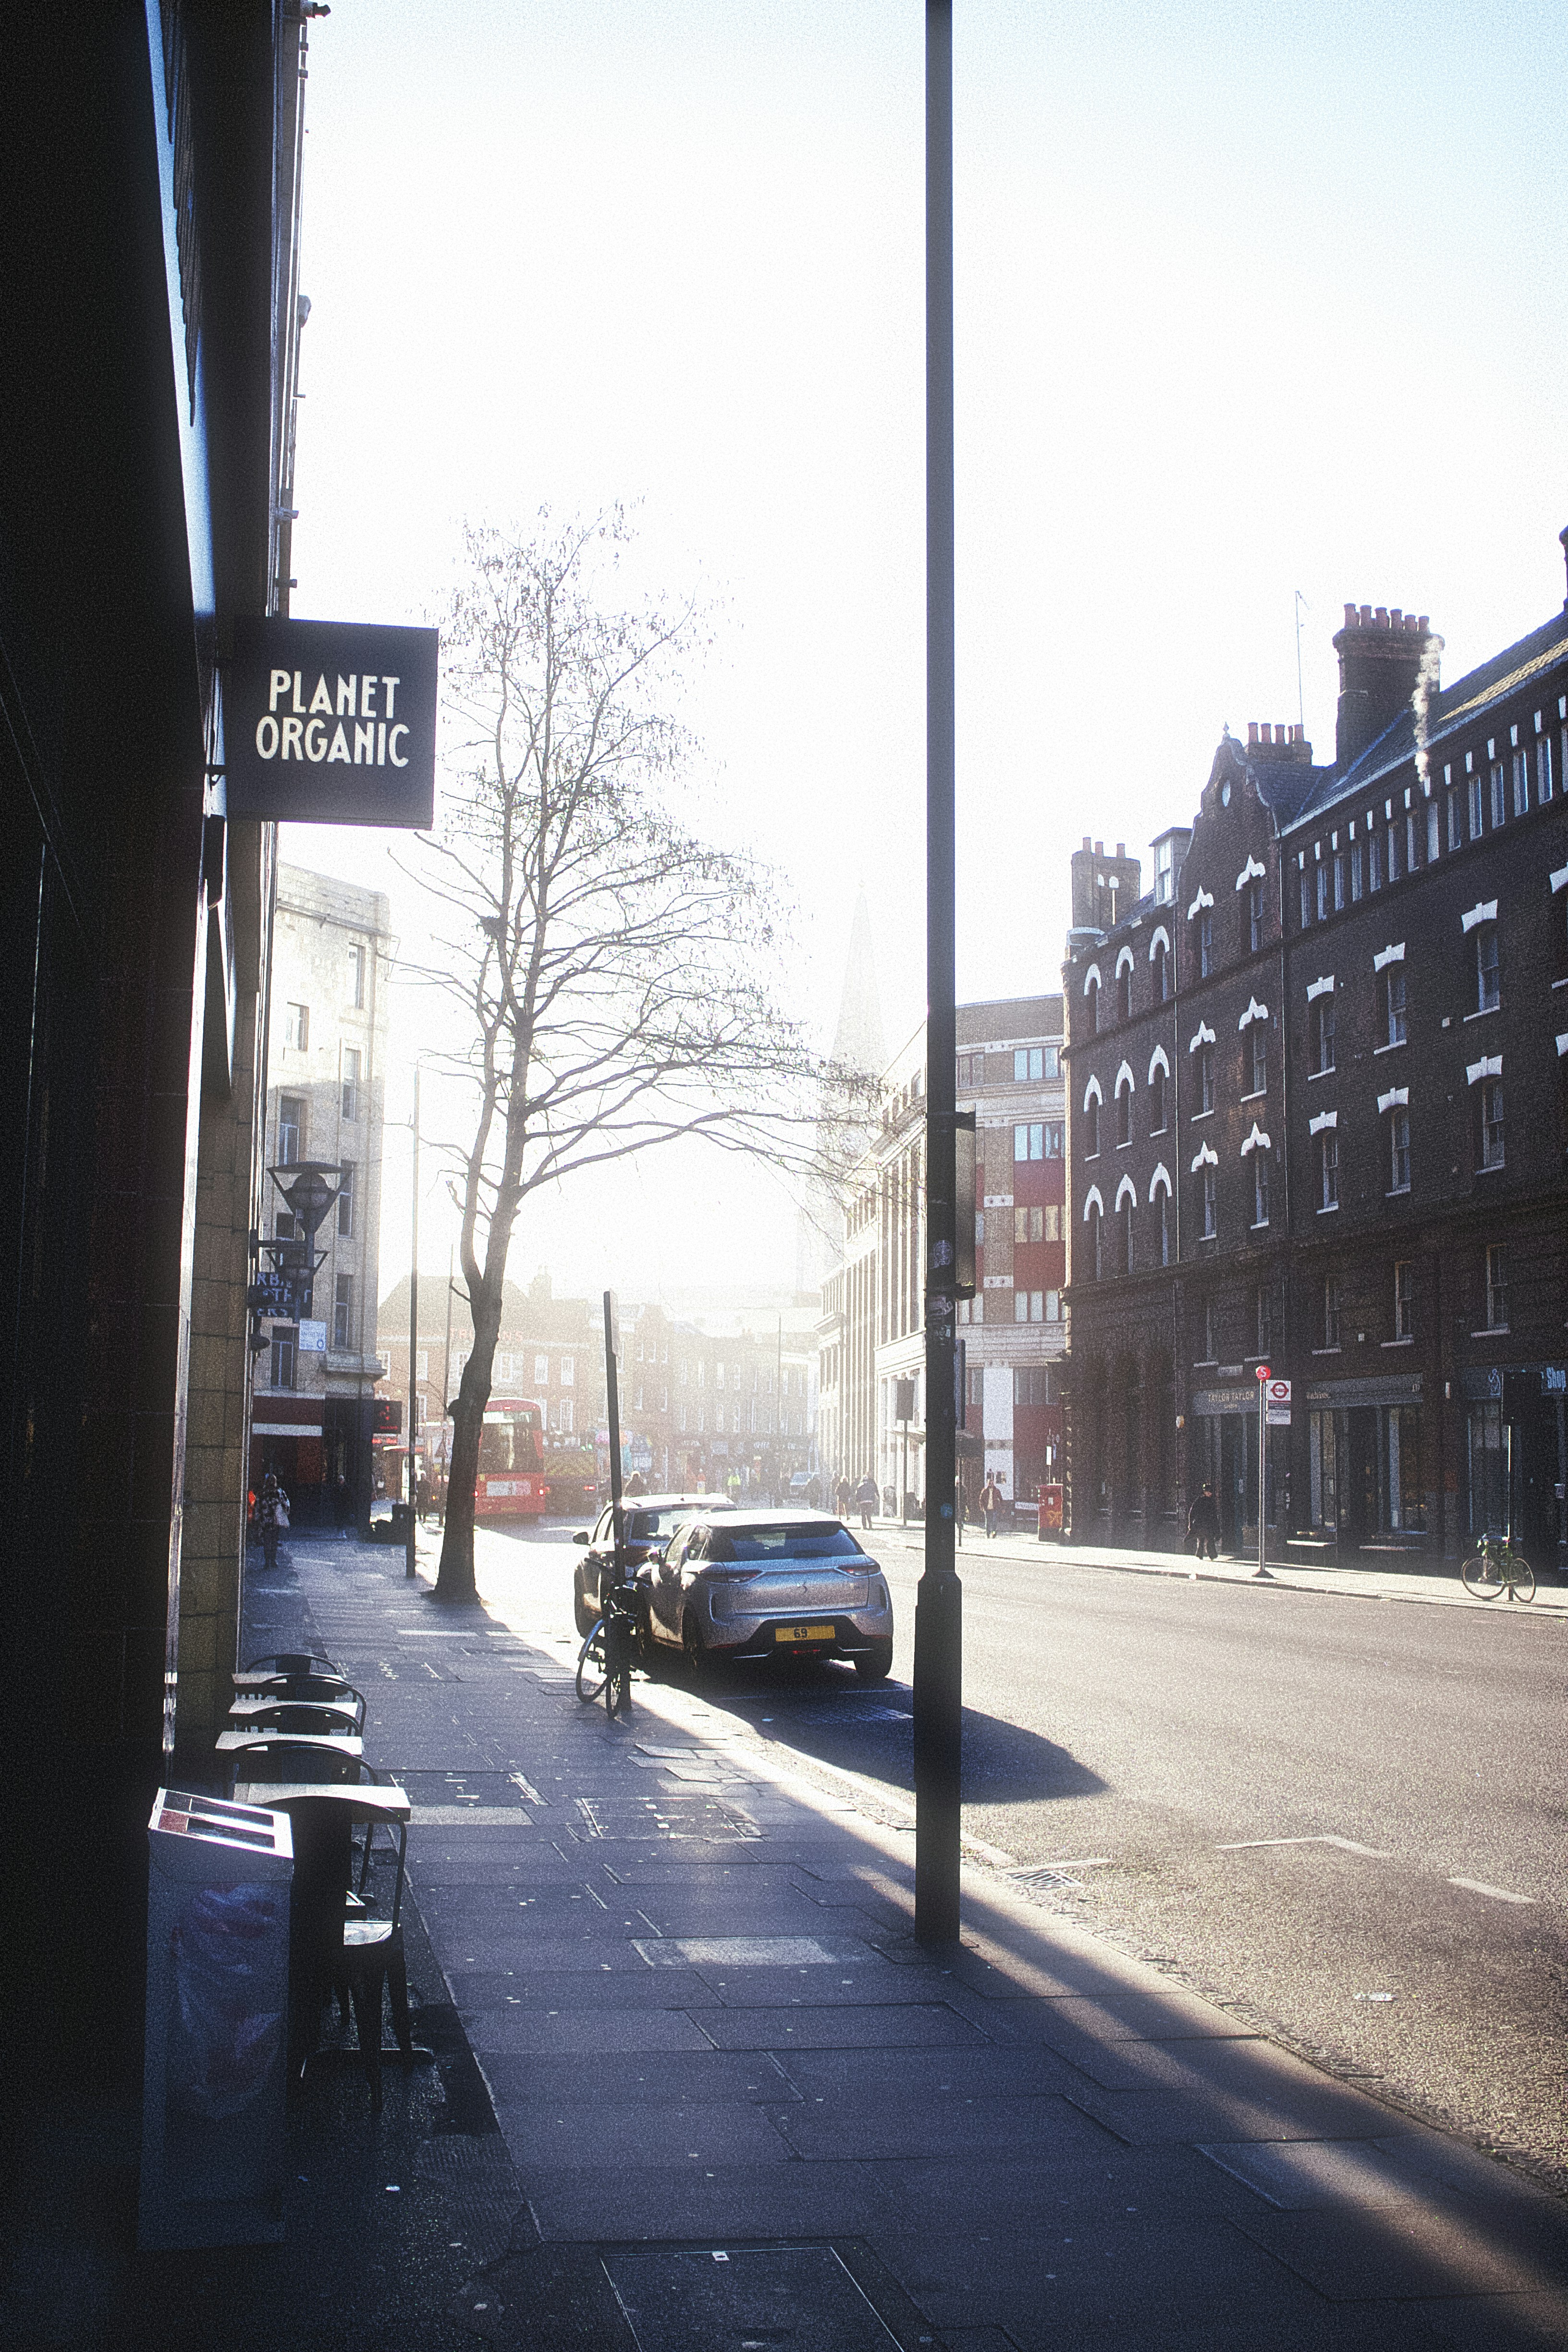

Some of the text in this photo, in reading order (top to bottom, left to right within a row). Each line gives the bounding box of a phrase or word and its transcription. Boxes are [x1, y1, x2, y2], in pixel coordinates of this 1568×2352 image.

[269, 669, 400, 719] PLANET
[256, 715, 410, 768] ORGANIC
[1261, 1367, 1267, 1377] S
[1546, 1367, 1567, 1392] Shop
[1231, 1391, 1254, 1400] TAYLOR
[794, 1628, 808, 1639] 69
